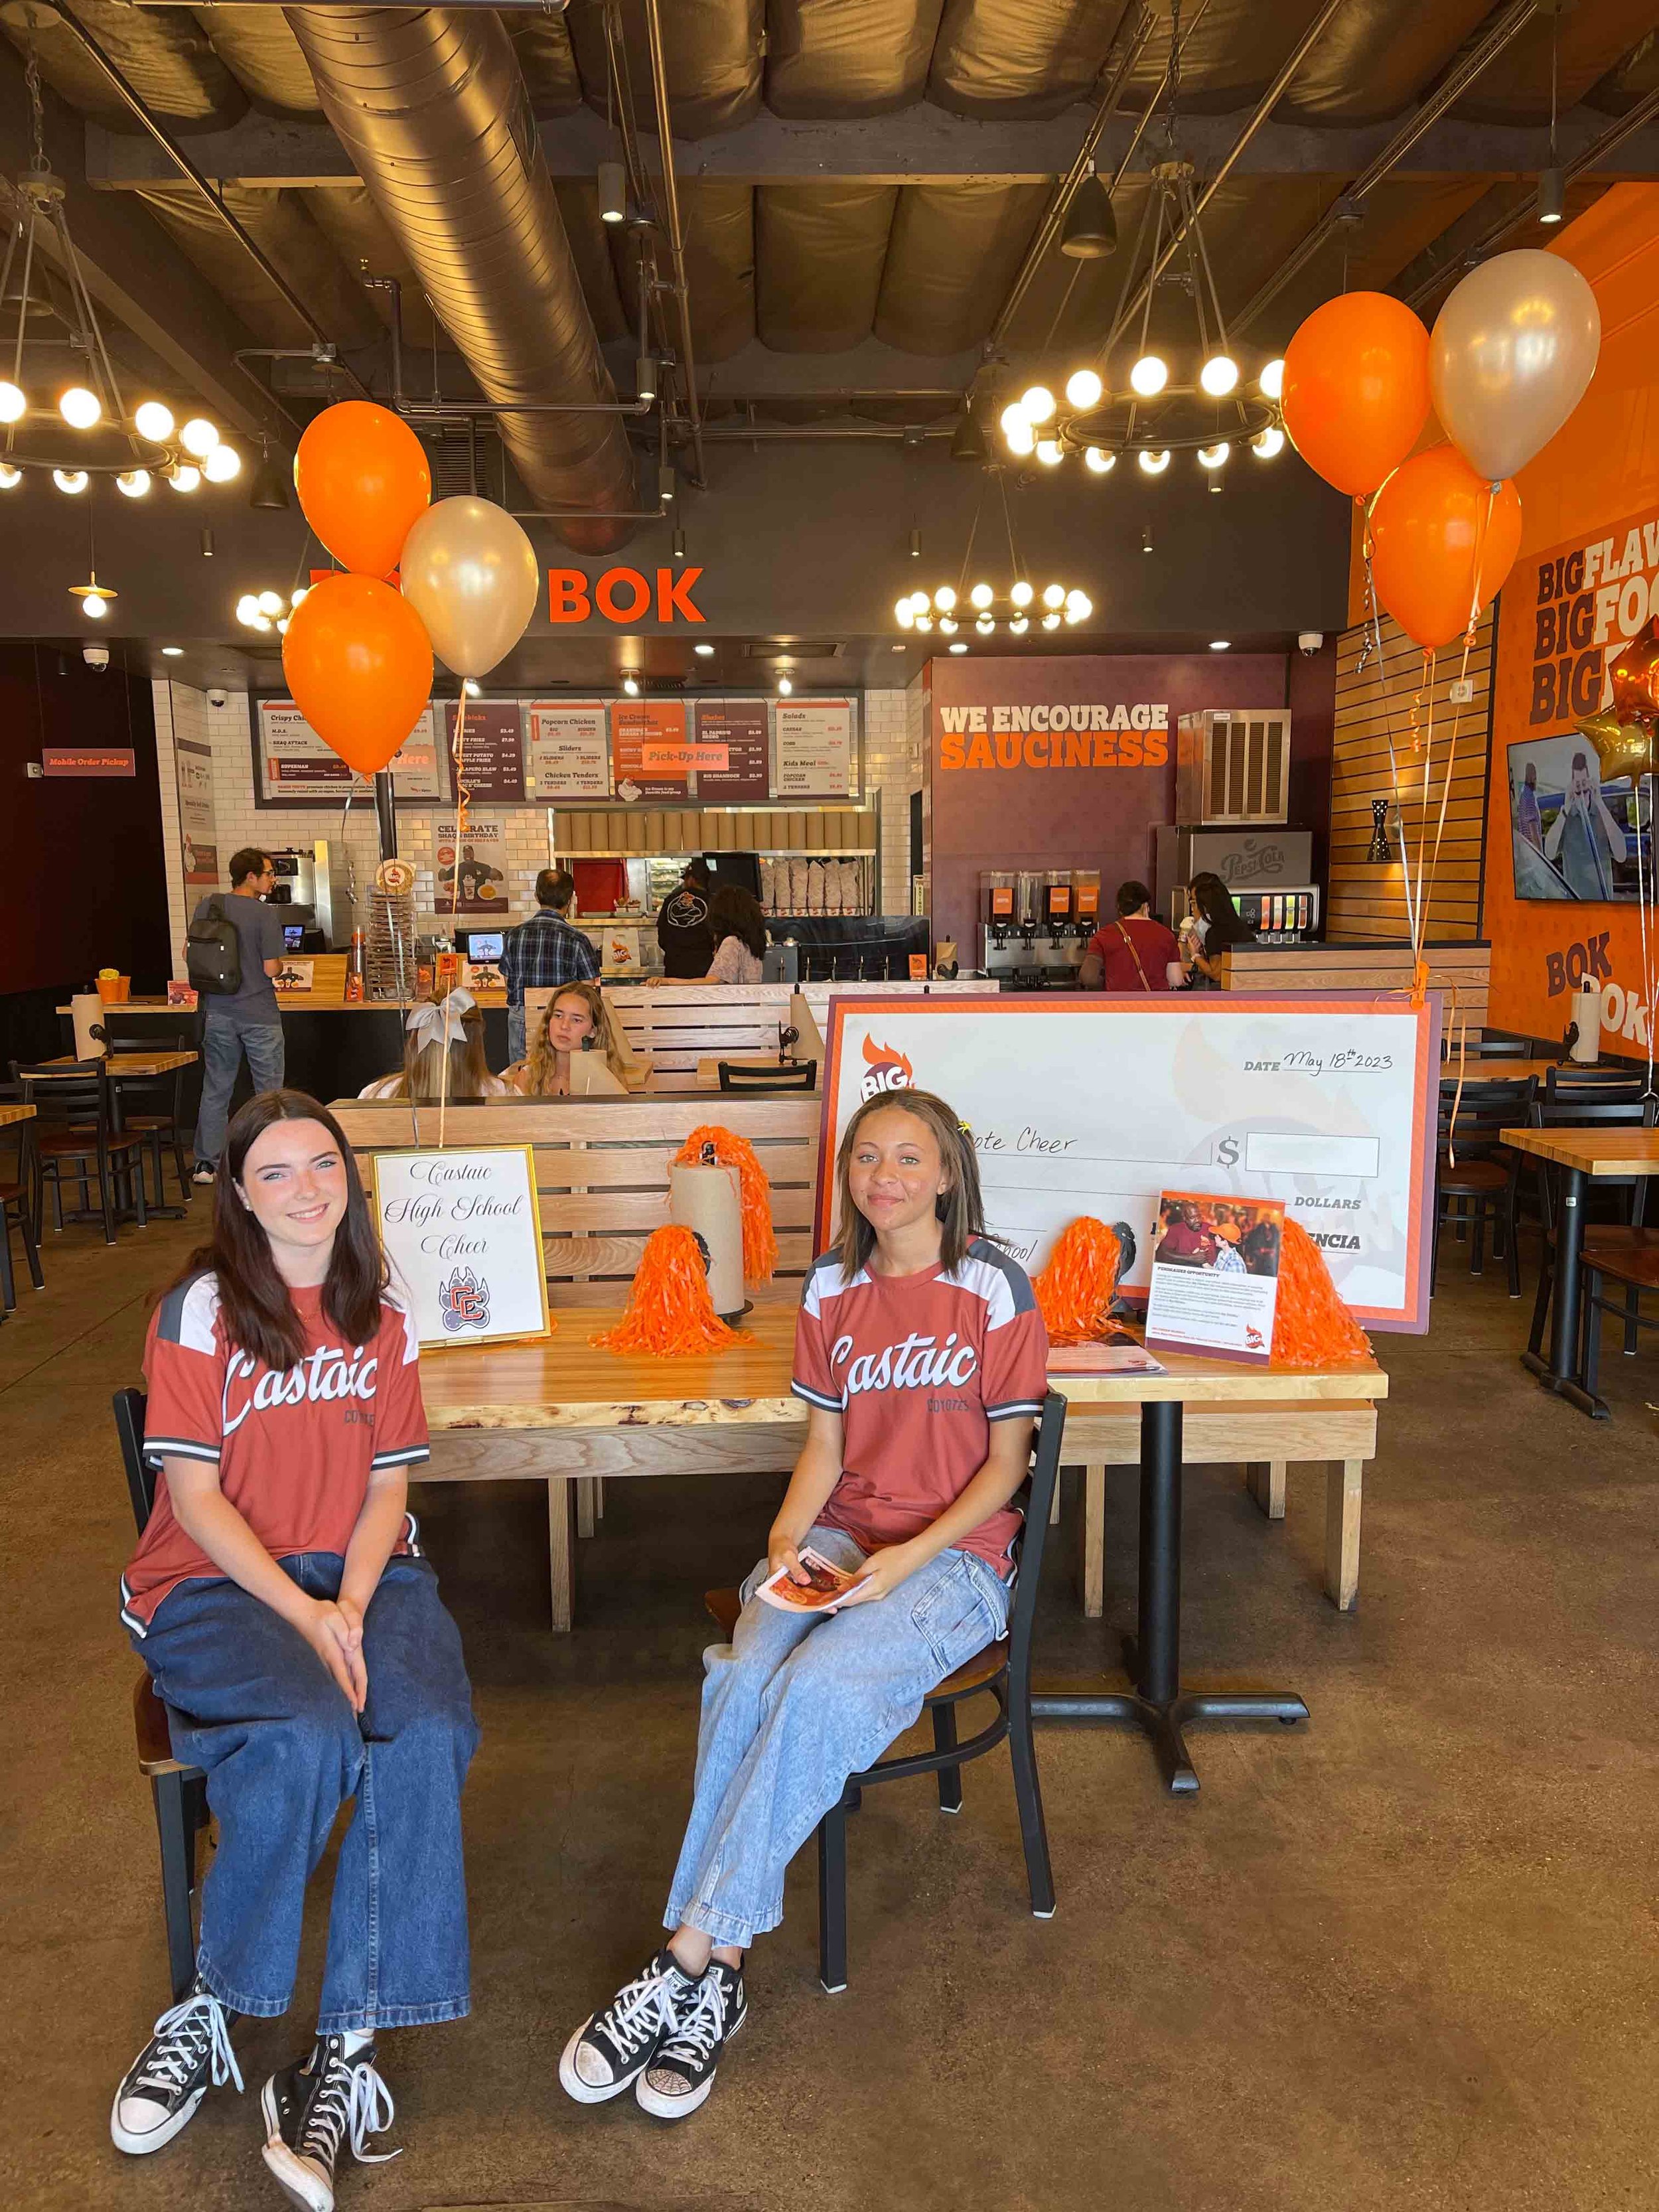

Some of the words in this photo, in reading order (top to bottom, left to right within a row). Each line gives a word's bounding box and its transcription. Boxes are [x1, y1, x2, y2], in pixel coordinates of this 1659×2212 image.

[1538, 550, 1583, 605] BIG
[547, 567, 707, 624] BOK
[1534, 593, 1594, 660] BIG
[1530, 650, 1601, 725] BIG
[940, 707, 987, 733] WE
[992, 703, 1169, 732] ENCOURAGE
[649, 751, 693, 763] Pick-Up
[696, 751, 722, 761] Here
[940, 731, 1169, 769] SAUCINESS
[1546, 931, 1612, 997] BOK
[1244, 1061, 1281, 1071] DATE
[1283, 1051, 1323, 1076] May
[1354, 1055, 1393, 1069] 2023
[861, 1066, 908, 1102] BIG
[974, 1130, 1006, 1151] ote
[1017, 1126, 1078, 1153] Cheer
[1216, 1136, 1240, 1169] $
[410, 1161, 492, 1186] Castaic
[384, 1193, 444, 1227] High
[451, 1195, 524, 1221] School
[1295, 1197, 1361, 1209] DOLLARS
[421, 1234, 489, 1261] Cheer
[1307, 1232, 1360, 1250] NCIA
[1245, 1333, 1260, 1343] BIG
[831, 1333, 977, 1411] Castaic
[222, 1345, 378, 1437] Castaic
[927, 1398, 969, 1413] COYOTES
